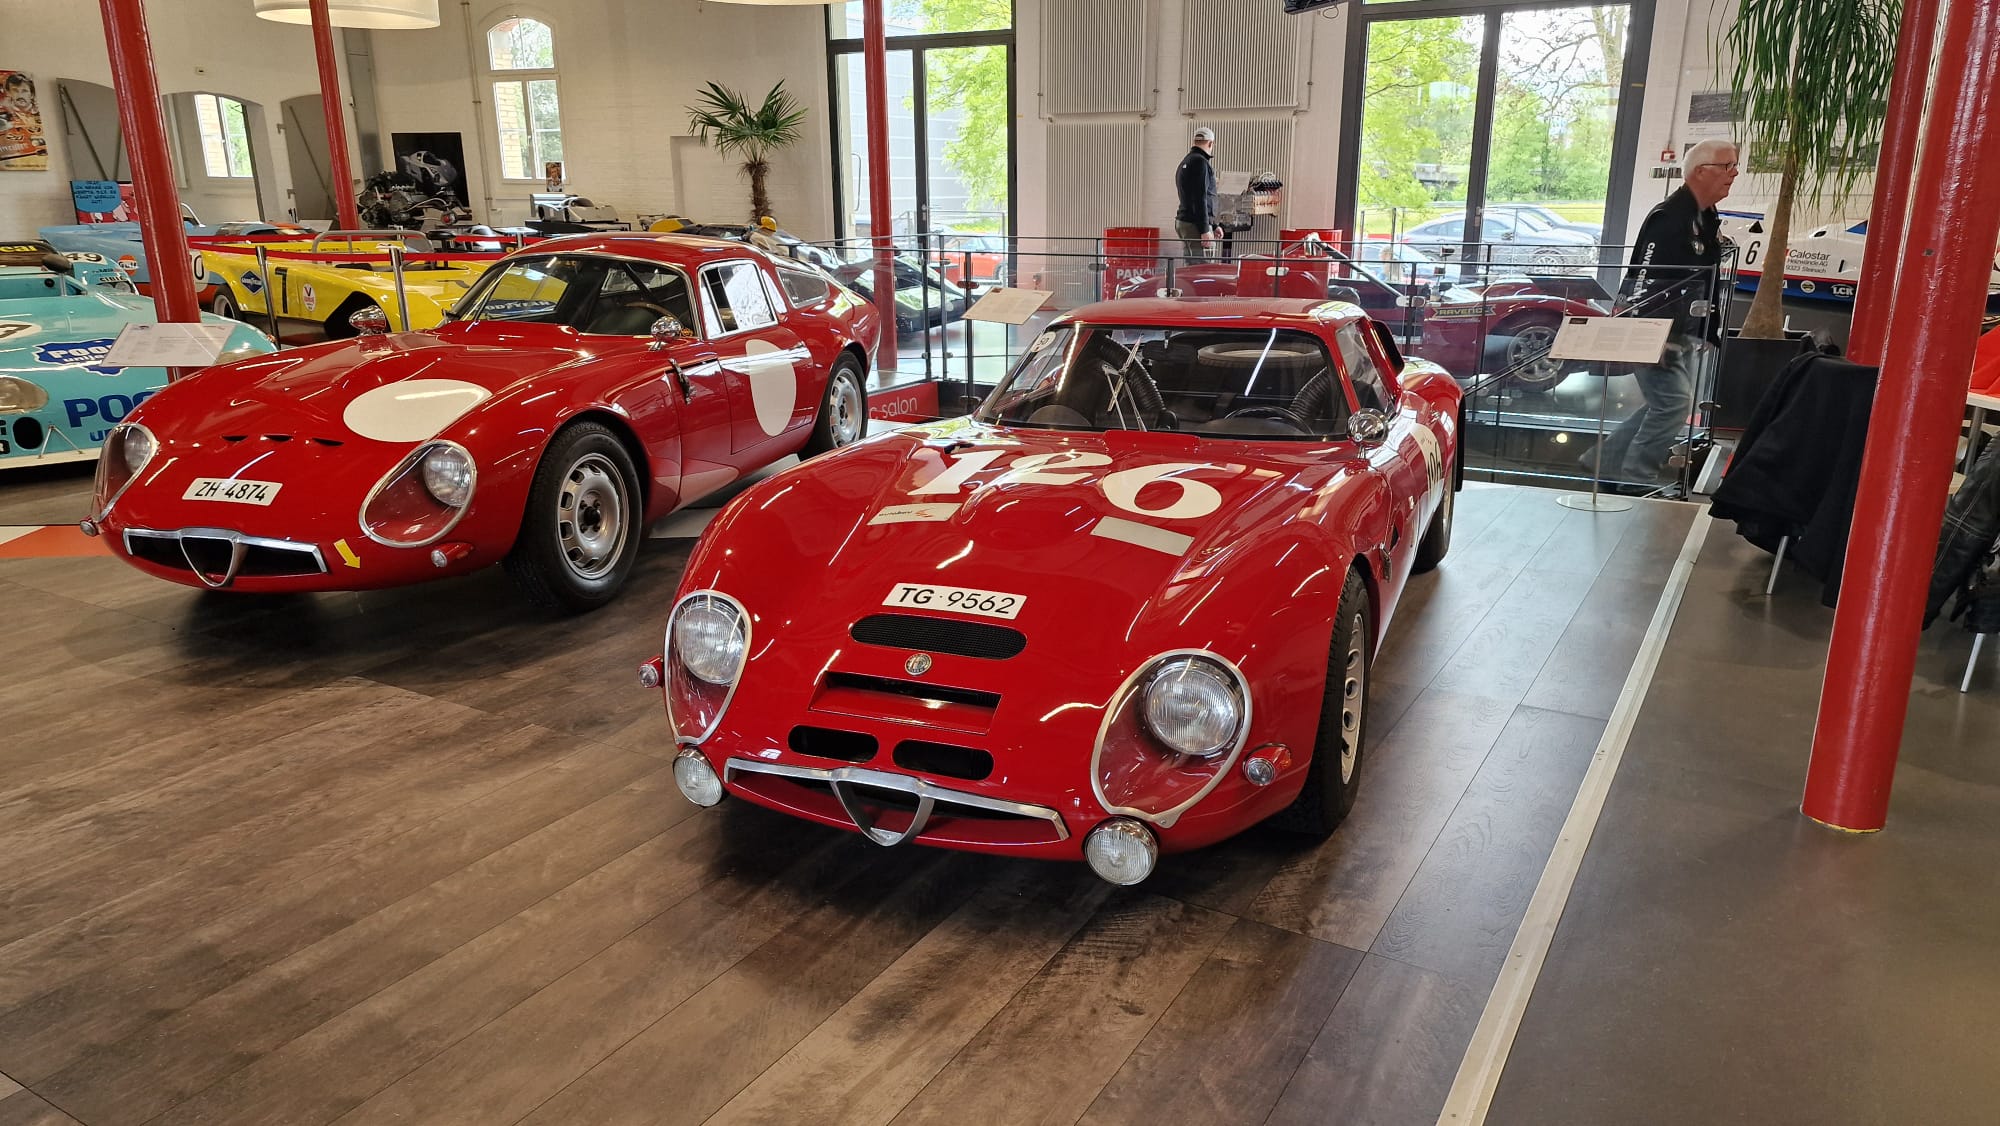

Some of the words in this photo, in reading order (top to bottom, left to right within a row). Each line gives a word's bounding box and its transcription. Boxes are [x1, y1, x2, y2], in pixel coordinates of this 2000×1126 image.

[1745, 241, 1761, 265] 6
[1789, 249, 1831, 261] Calostar
[882, 397, 918, 419] salon
[907, 450, 1226, 519] 126
